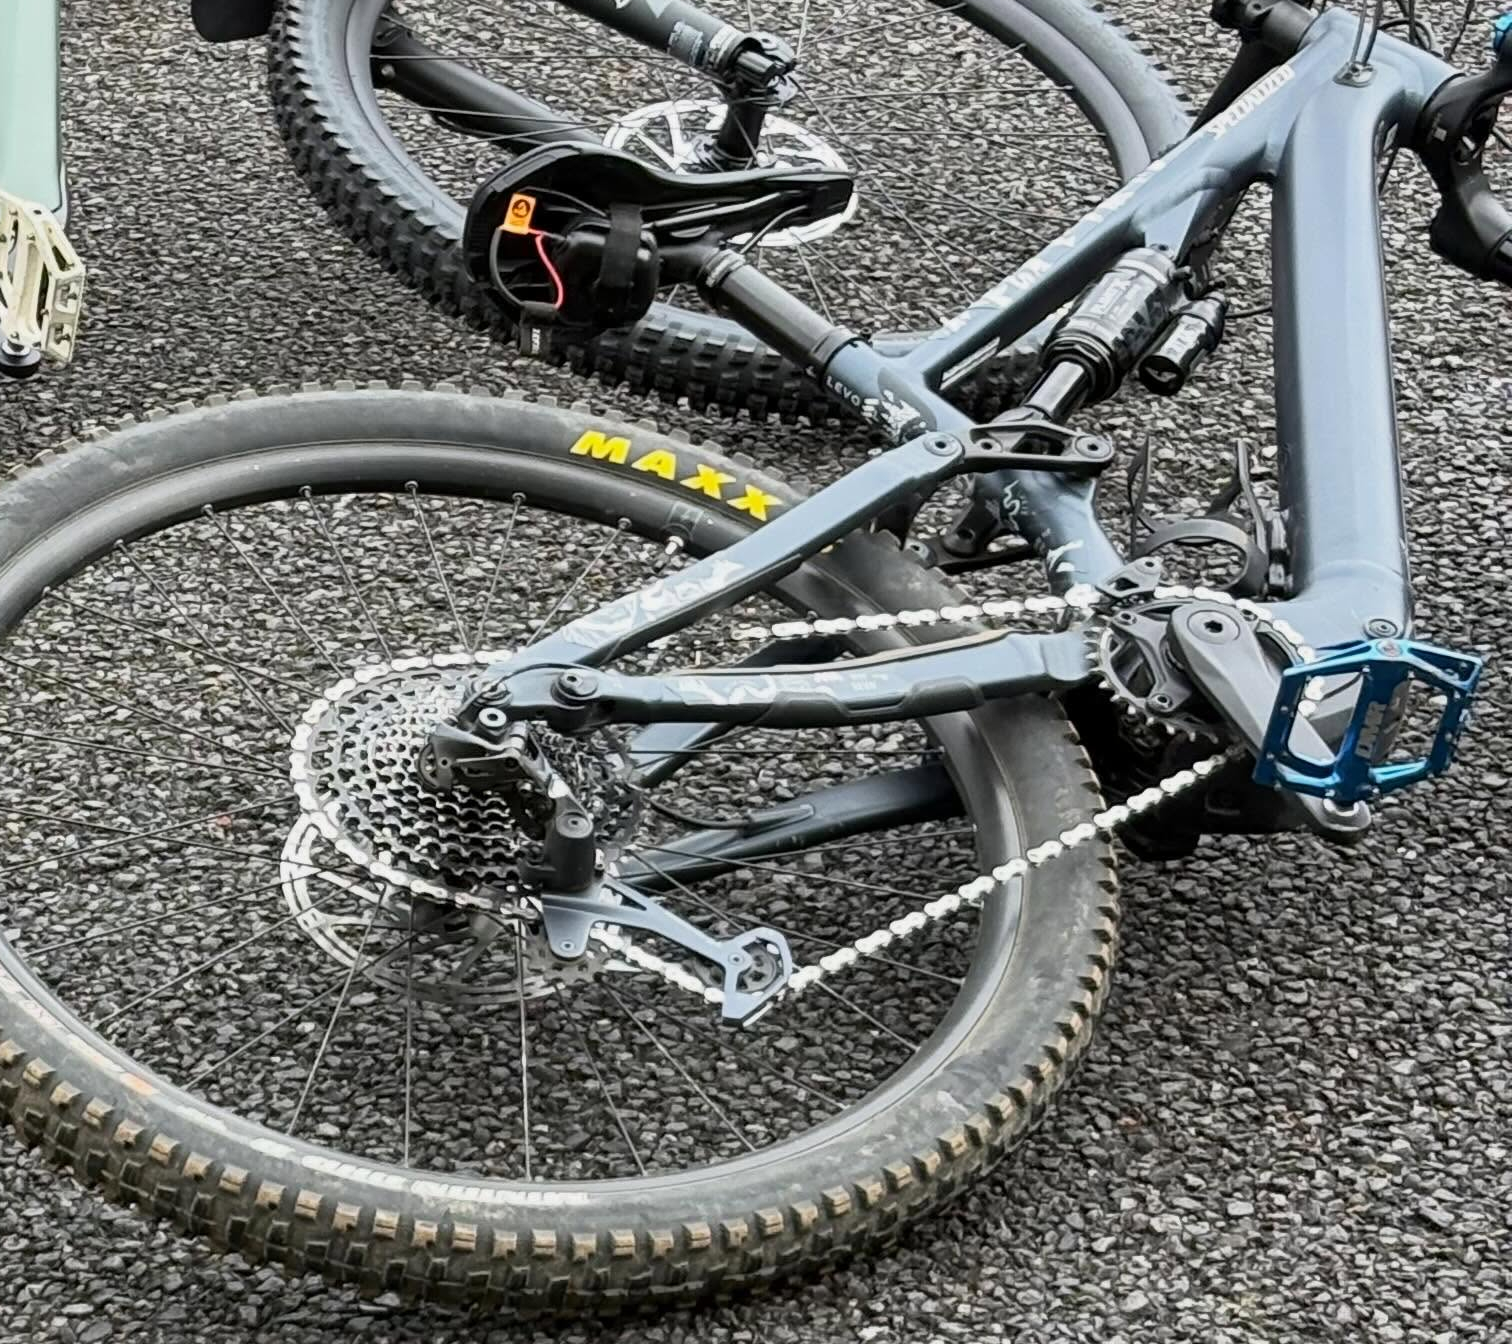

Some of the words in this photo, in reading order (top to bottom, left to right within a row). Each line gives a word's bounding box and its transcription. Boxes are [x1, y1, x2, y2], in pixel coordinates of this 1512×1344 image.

[1205, 62, 1296, 141] SPECIALIZED
[825, 375, 861, 406] LEVO
[569, 430, 784, 522] MAXX
